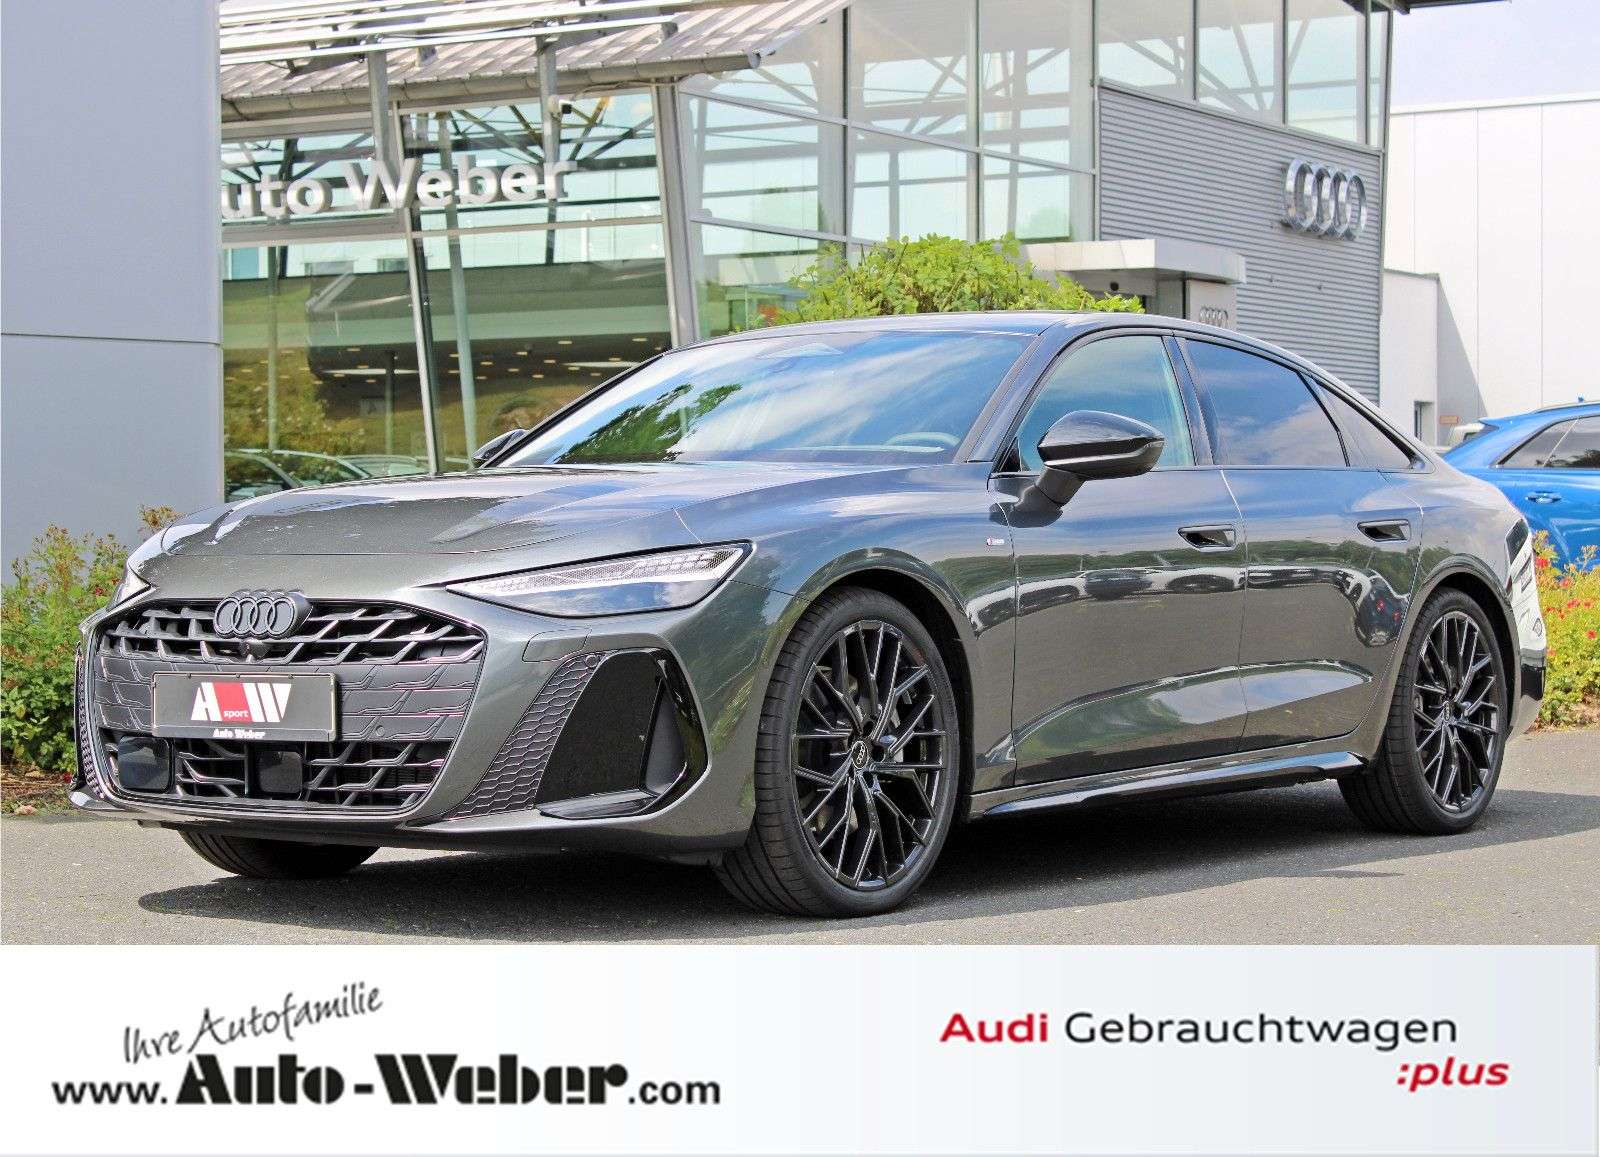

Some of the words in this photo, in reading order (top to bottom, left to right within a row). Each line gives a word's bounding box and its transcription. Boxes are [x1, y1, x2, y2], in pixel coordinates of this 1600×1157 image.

[221, 171, 333, 219] uto
[345, 154, 577, 210] Weber
[223, 710, 249, 719] sport
[212, 728, 233, 738] Auto
[235, 729, 266, 739] Weber
